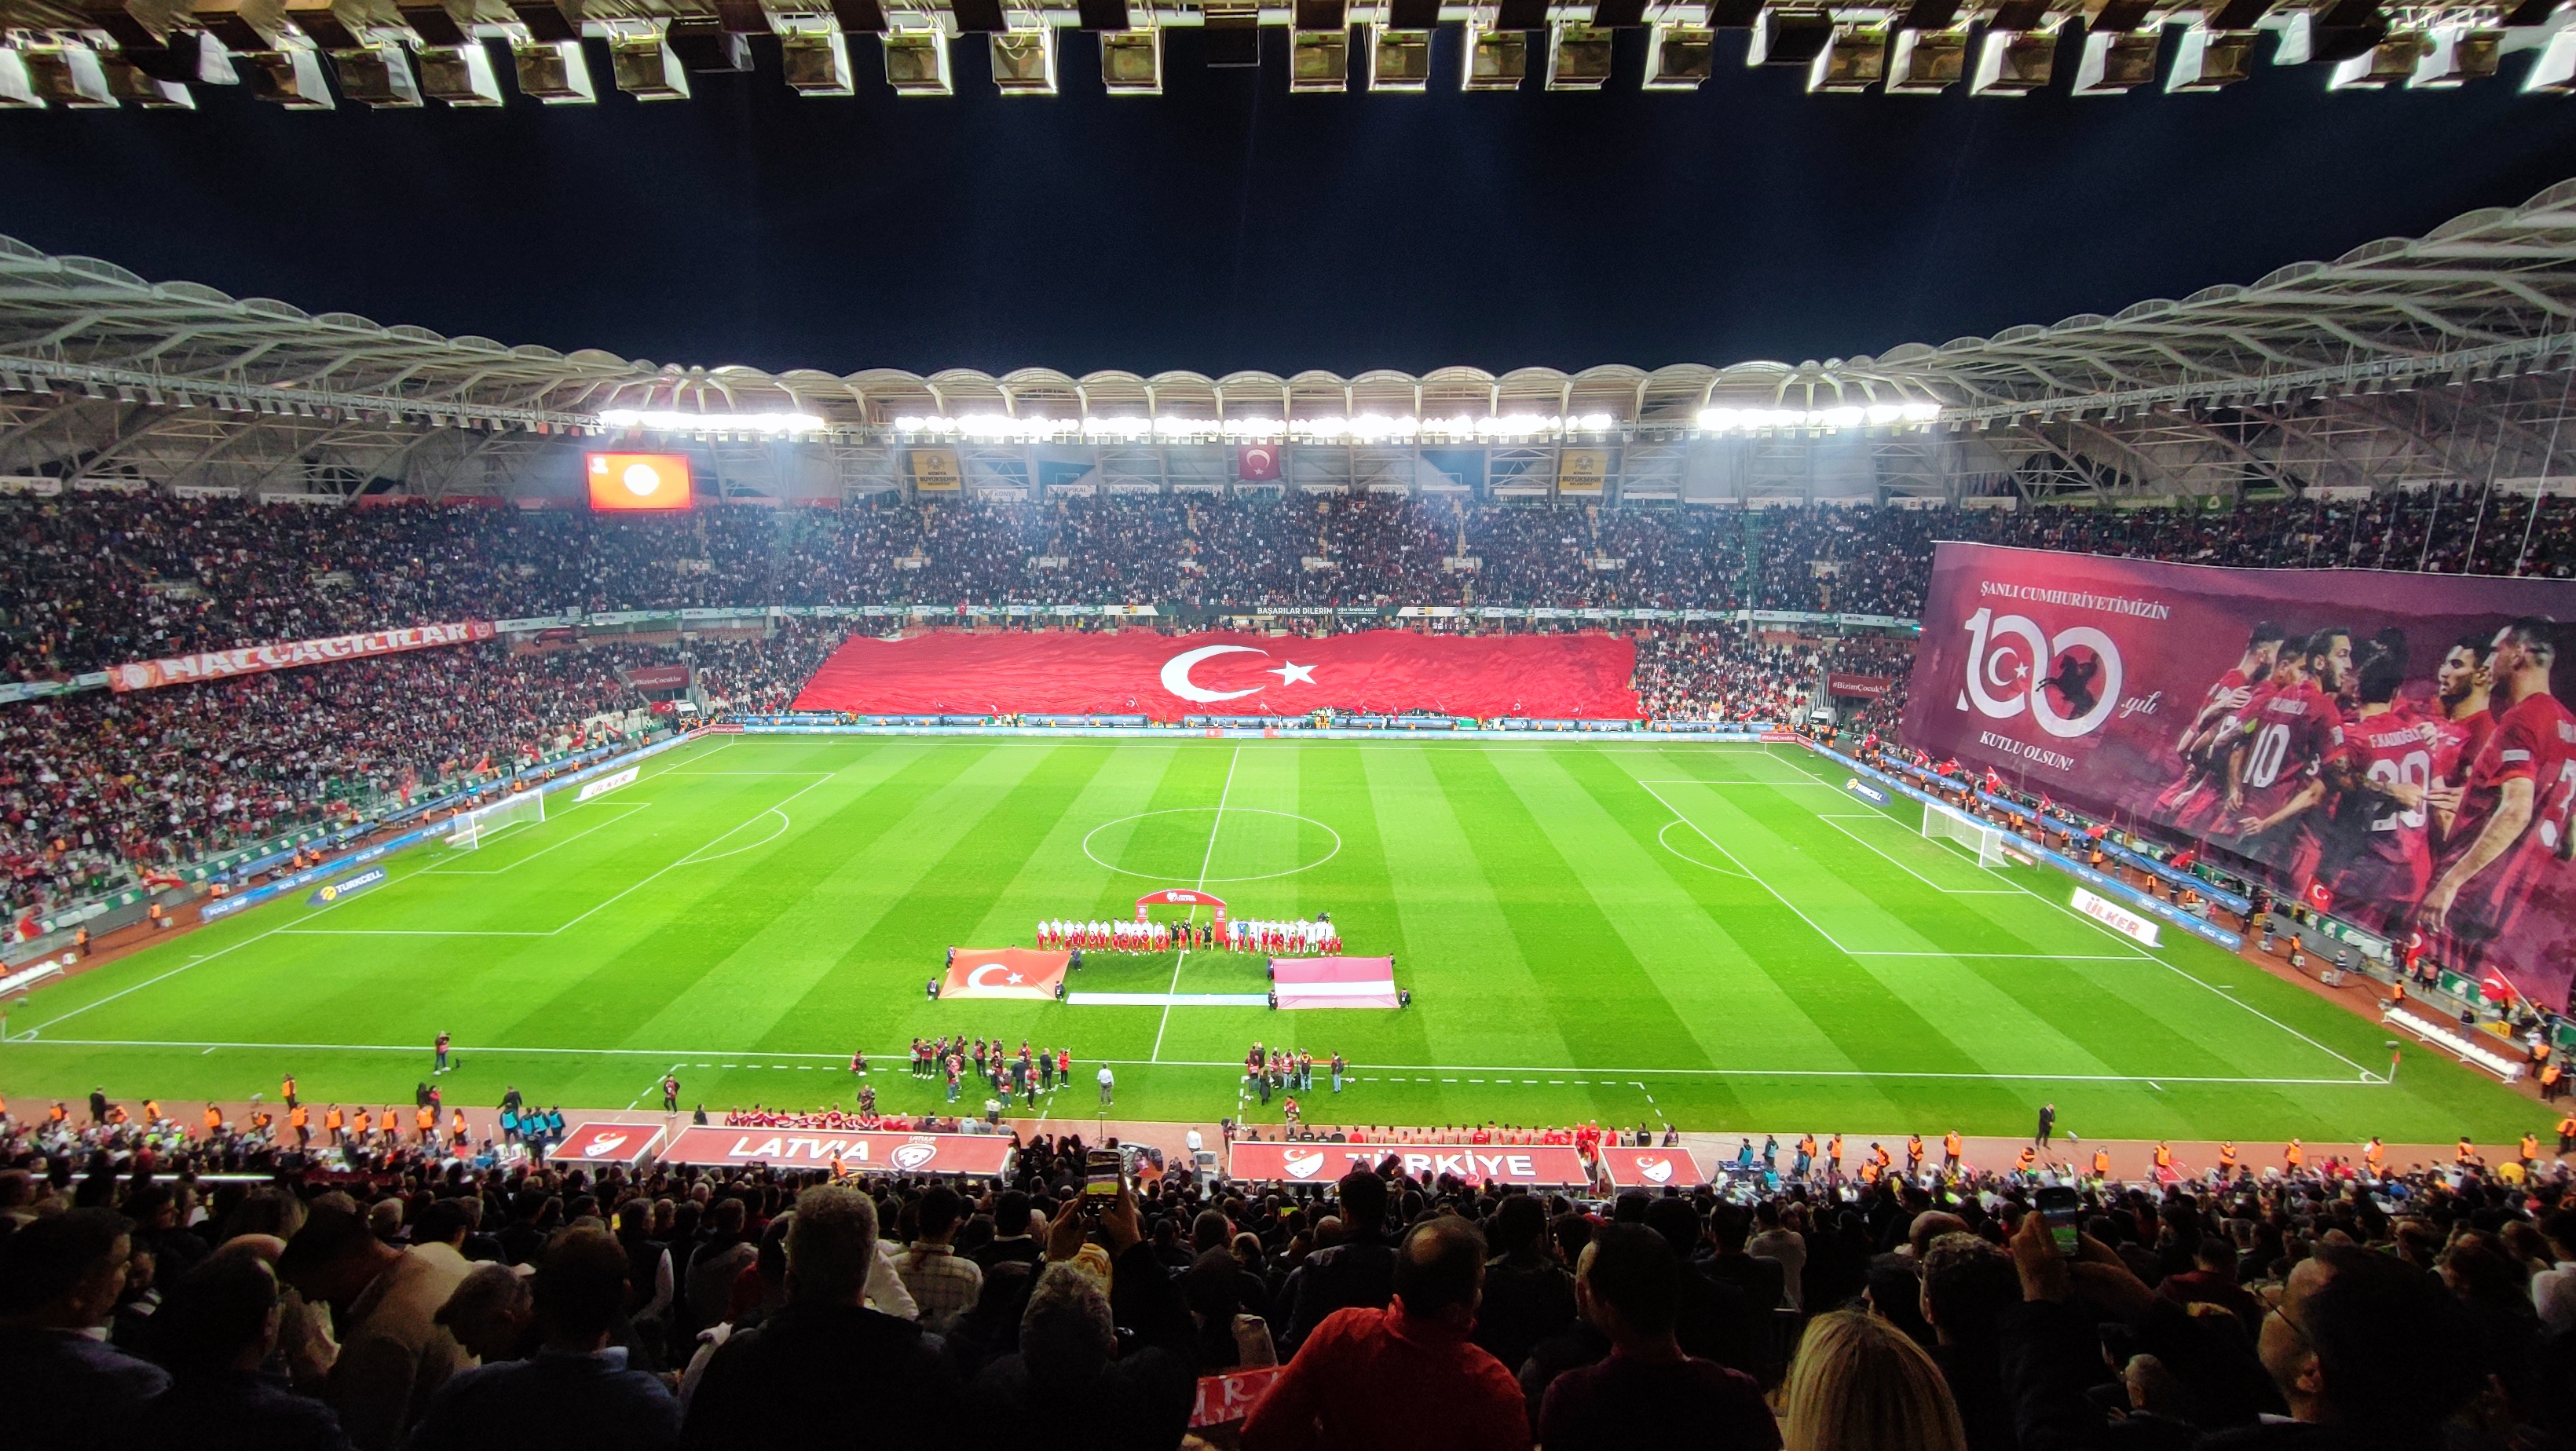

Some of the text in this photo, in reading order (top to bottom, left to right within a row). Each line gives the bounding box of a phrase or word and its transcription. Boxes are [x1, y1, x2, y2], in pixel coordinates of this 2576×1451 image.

[1257, 607, 1301, 616] BAŞARILAR
[1981, 580, 2171, 620] ŞANLI CUMHURİYETİMİZİN
[1832, 682, 1886, 693] #BizimÇocukl
[1956, 607, 2124, 738] 100
[1979, 730, 2074, 771] KUTLU OLSUN!
[2242, 722, 2291, 788] 10
[335, 870, 383, 894] TURKCELL
[2084, 896, 2140, 937] ÜLKER
[729, 1136, 869, 1161] LATVIA
